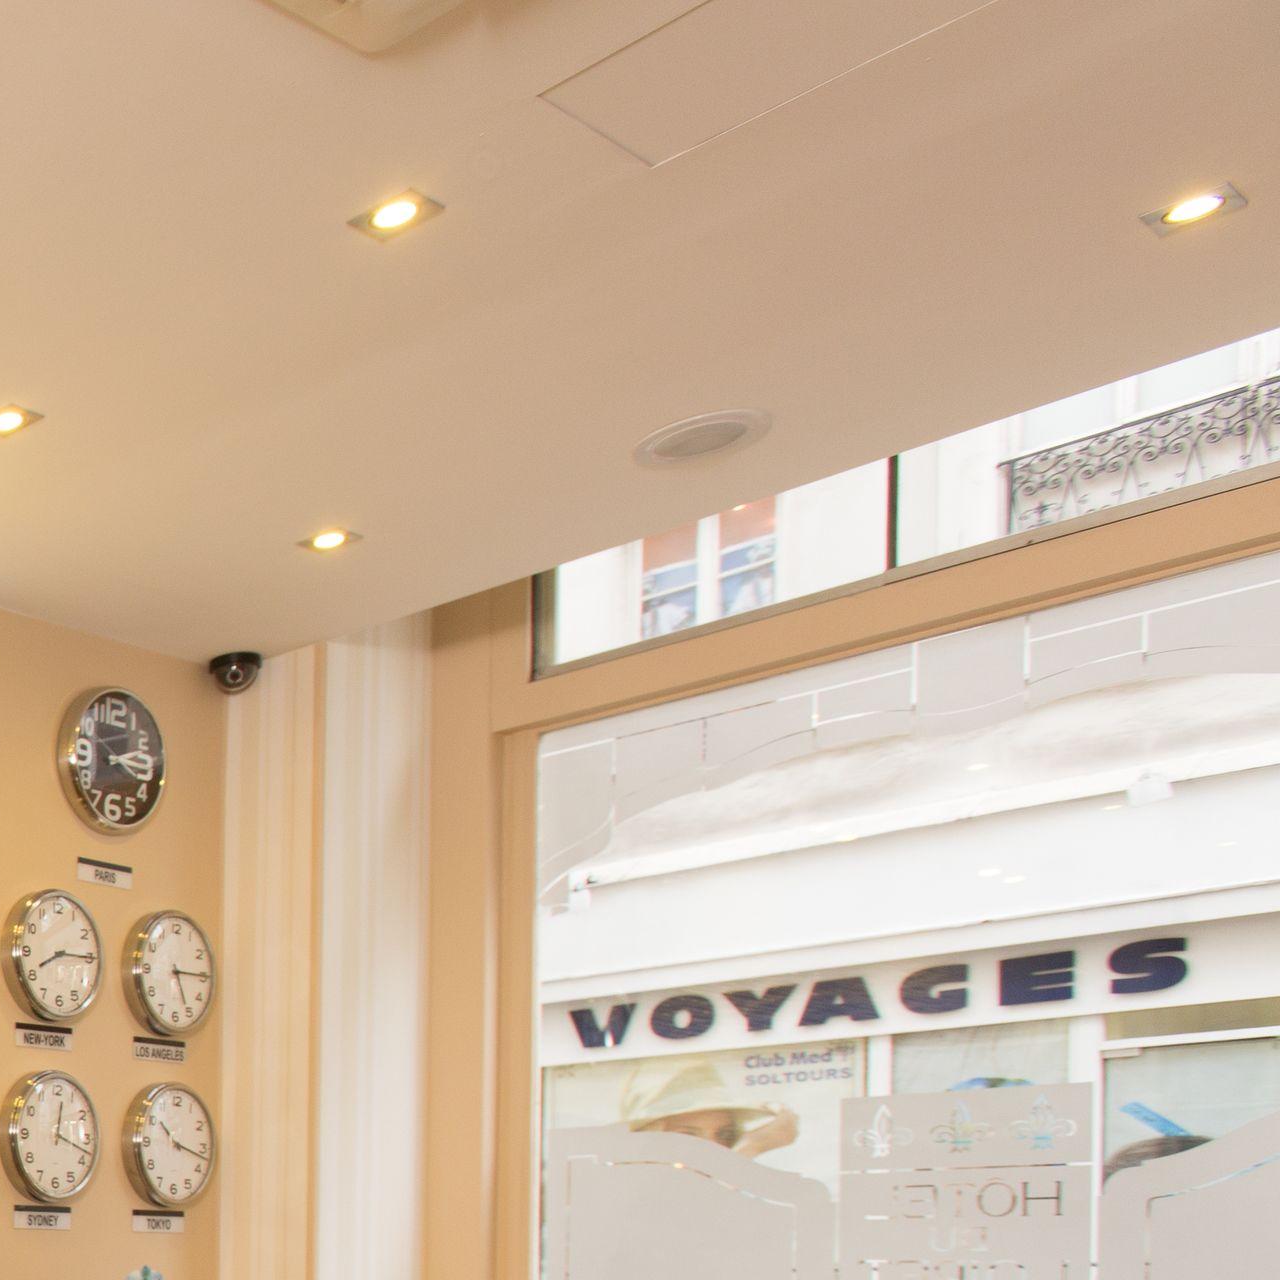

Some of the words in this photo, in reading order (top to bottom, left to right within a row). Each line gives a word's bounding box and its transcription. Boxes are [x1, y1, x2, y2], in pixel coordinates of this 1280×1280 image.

[94, 702, 106, 722] 11
[106, 697, 128, 729] 12
[129, 712, 136, 731] 1
[80, 717, 95, 736] 10
[138, 730, 149, 750] 2
[76, 738, 92, 767] 9
[136, 751, 154, 782] 3
[80, 769, 91, 790] 8
[91, 789, 102, 808] 7
[136, 783, 148, 802] 4
[104, 793, 121, 821] 6
[124, 797, 136, 817] 5
[94, 869, 117, 884] PARIS
[53, 902, 63, 914] 12
[28, 923, 36, 934] 10
[80, 929, 88, 940] 2
[172, 924, 181, 934] 12
[22, 945, 31, 956] 9
[28, 969, 37, 981] 8
[40, 988, 47, 999] 7
[55, 995, 64, 1007] 6
[70, 990, 79, 1001] 5
[568, 937, 1189, 1050] VOYAGES
[23, 1032, 66, 1048] NEW-YORK
[135, 1046, 151, 1058] LOS
[151, 1047, 185, 1062] ANGELES
[744, 1051, 785, 1069] Club
[788, 1048, 833, 1066] Med
[744, 1067, 853, 1087] SOLTOURS
[27, 1214, 59, 1228] SYDNEY
[146, 1217, 171, 1231] TOKYO
